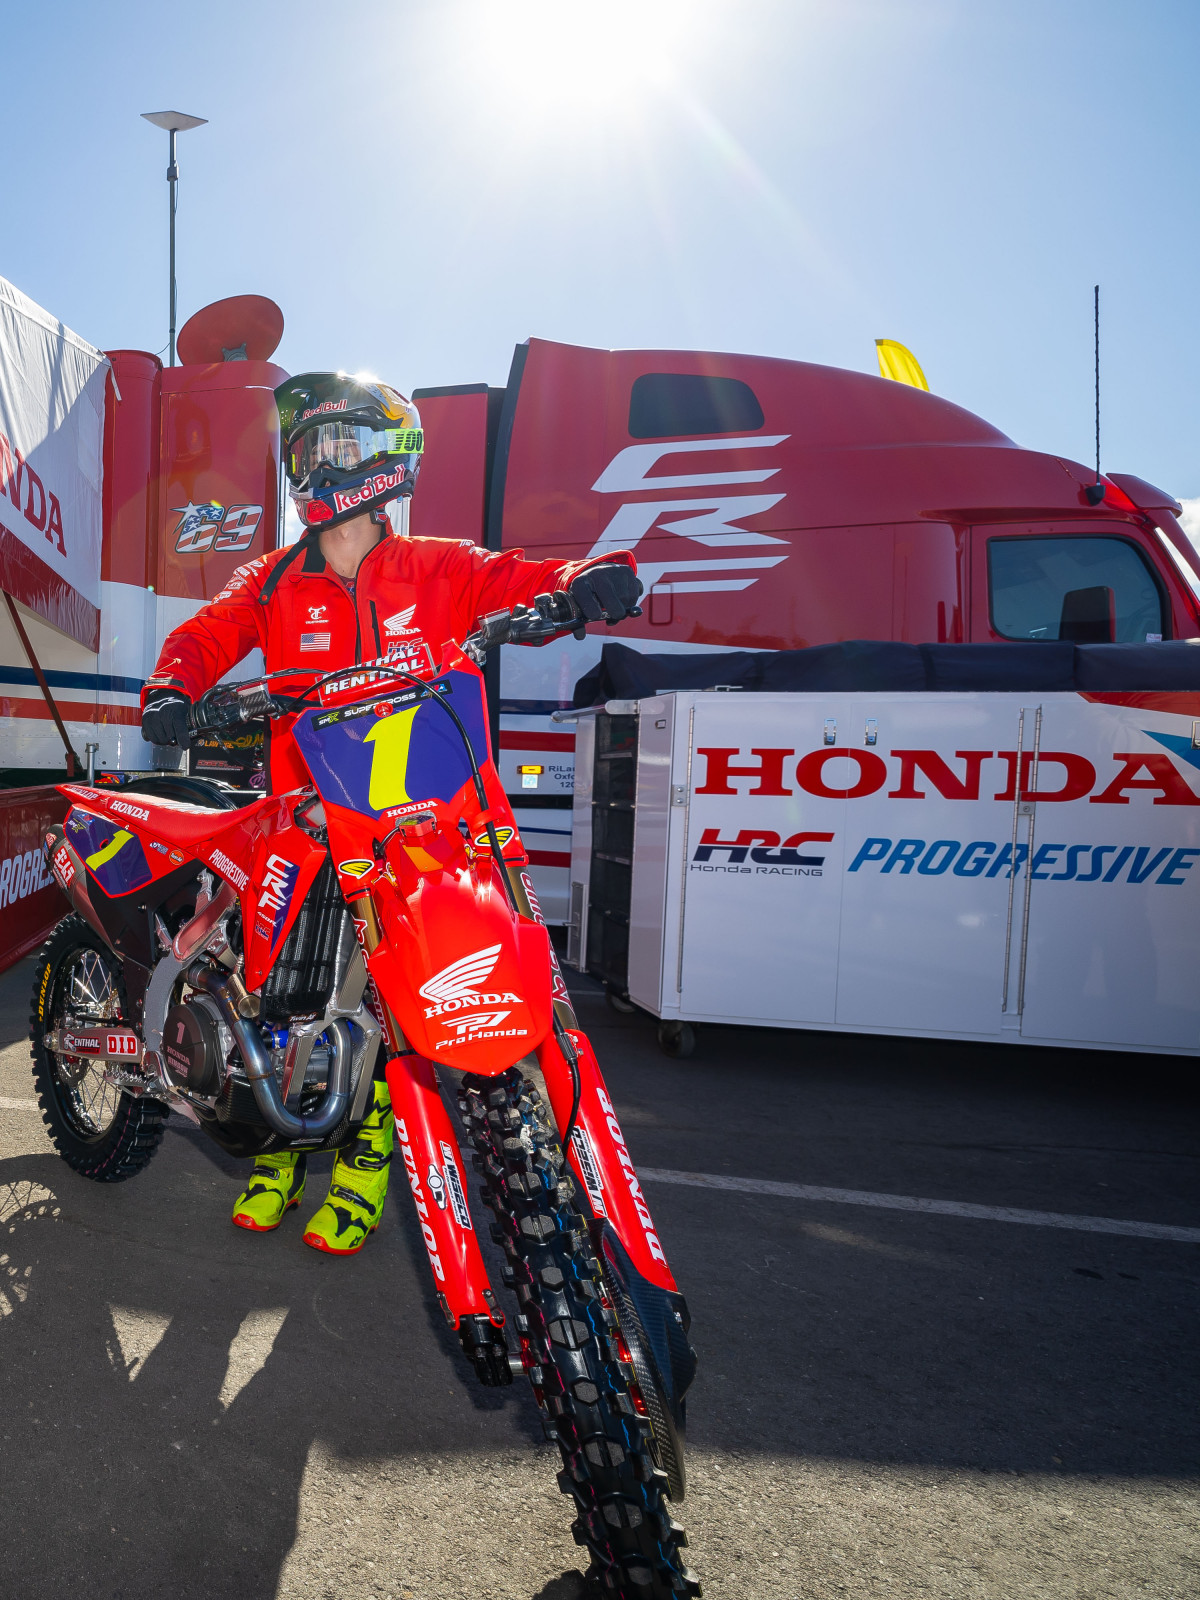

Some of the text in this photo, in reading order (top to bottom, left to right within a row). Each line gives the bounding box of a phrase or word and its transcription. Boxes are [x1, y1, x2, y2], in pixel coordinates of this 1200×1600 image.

[303, 400, 347, 420] Red Bull
[334, 464, 406, 514] Red Bull
[174, 502, 264, 554] 69
[385, 627, 421, 636] HONDA
[344, 692, 417, 718] SUPEROSS
[363, 704, 422, 811] 1
[695, 746, 1200, 806] HONDA
[110, 800, 150, 821] HONDA
[387, 801, 438, 818] HONDA
[86, 830, 134, 871] 1
[693, 828, 835, 866] HRC
[847, 837, 1200, 886] PROGRESSIVE
[208, 848, 250, 891] PROGRESSIVE
[258, 854, 294, 911] CRF
[690, 864, 823, 876] Honda RACING
[38, 963, 51, 1017] DUNLOP
[424, 993, 523, 1019] HONDA
[436, 1029, 528, 1050] Pro Honda
[394, 1113, 445, 1282] DUNLOP
[594, 1087, 667, 1266] DUNLOP
